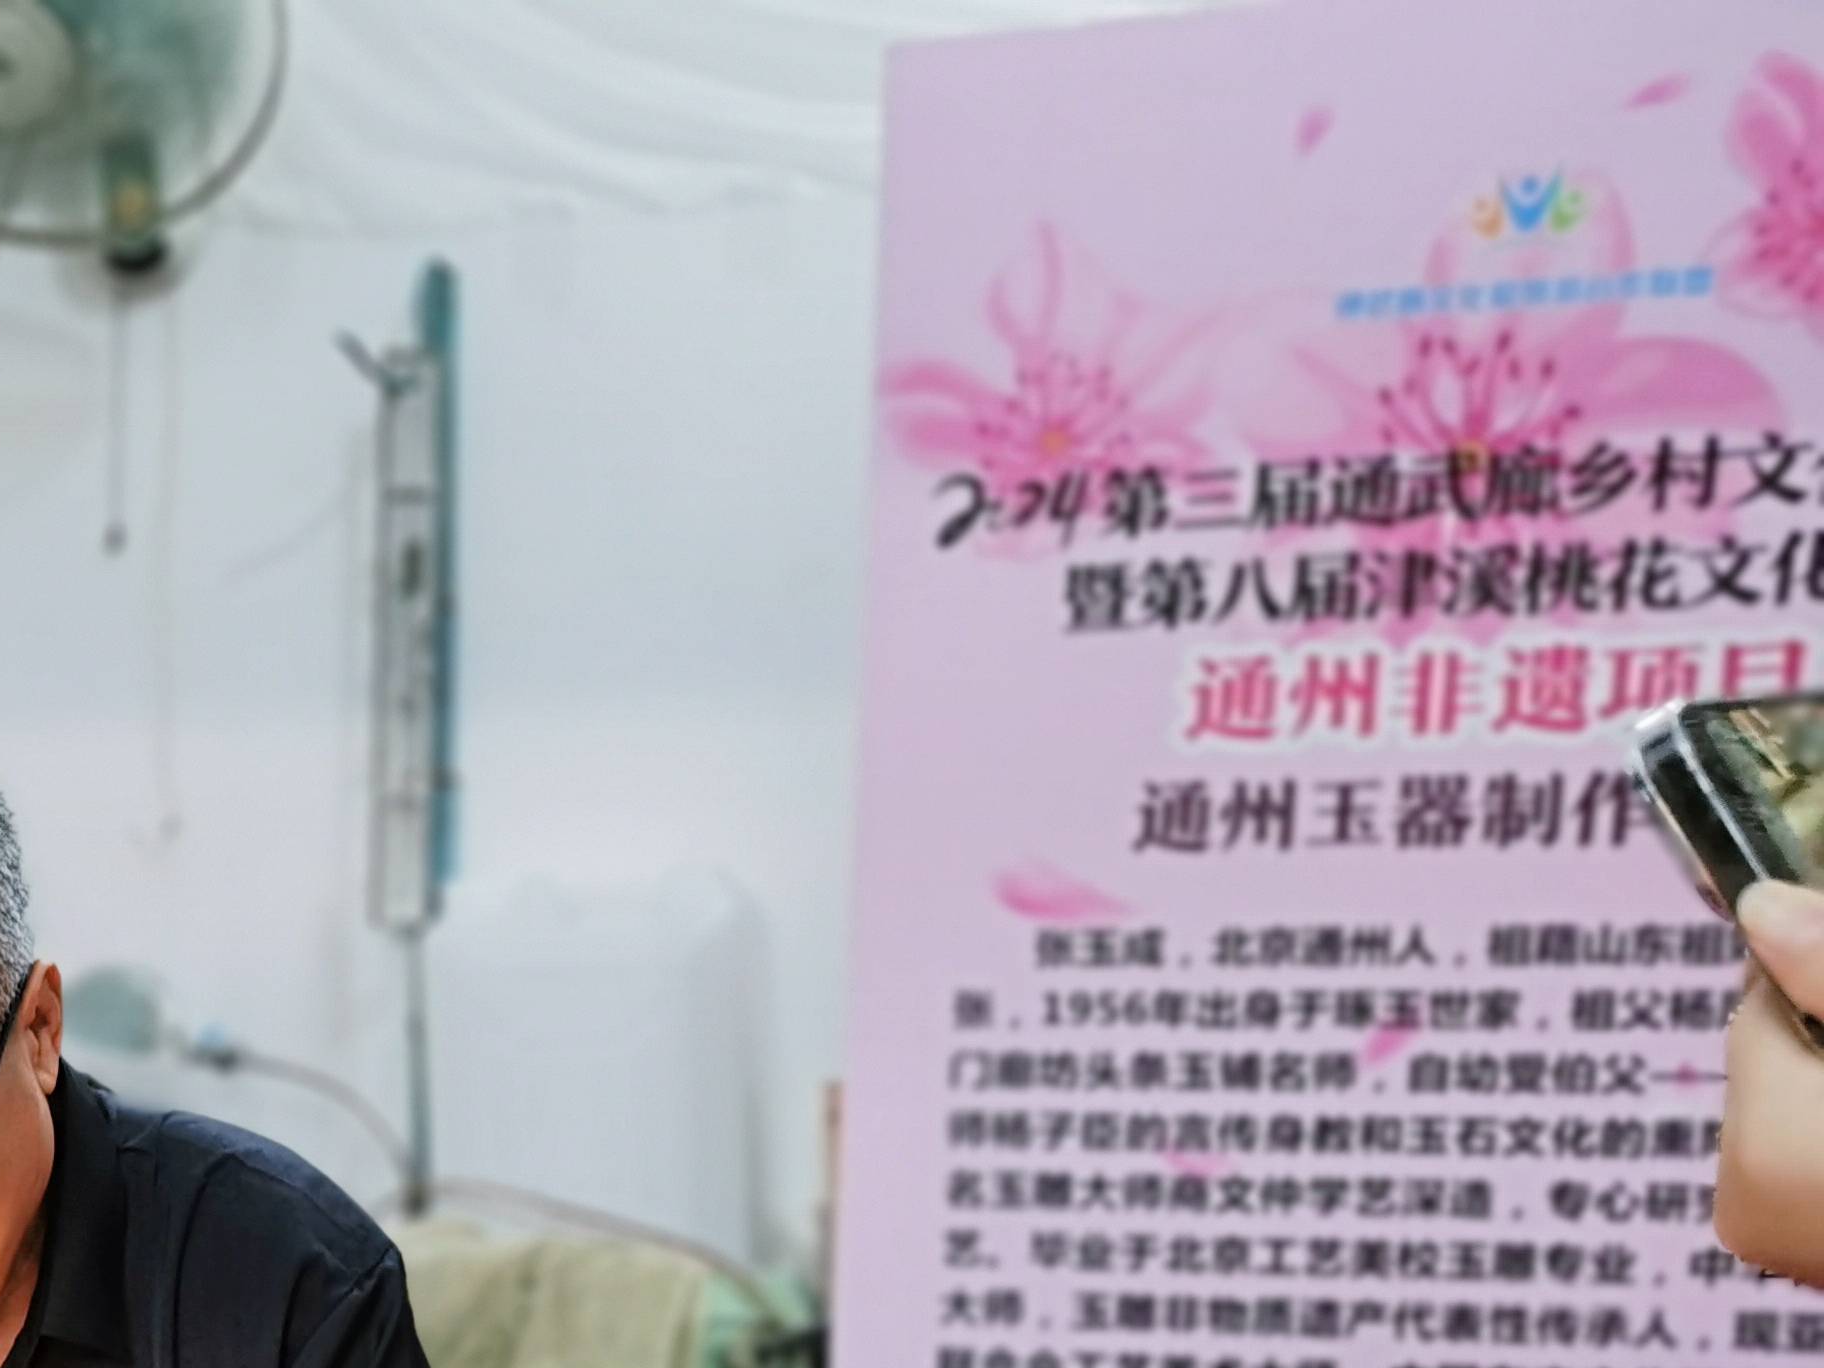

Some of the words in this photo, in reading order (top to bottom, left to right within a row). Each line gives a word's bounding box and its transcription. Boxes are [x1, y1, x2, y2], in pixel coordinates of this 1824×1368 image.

[931, 434, 1824, 551] 2024第三届通武廊乡村文
